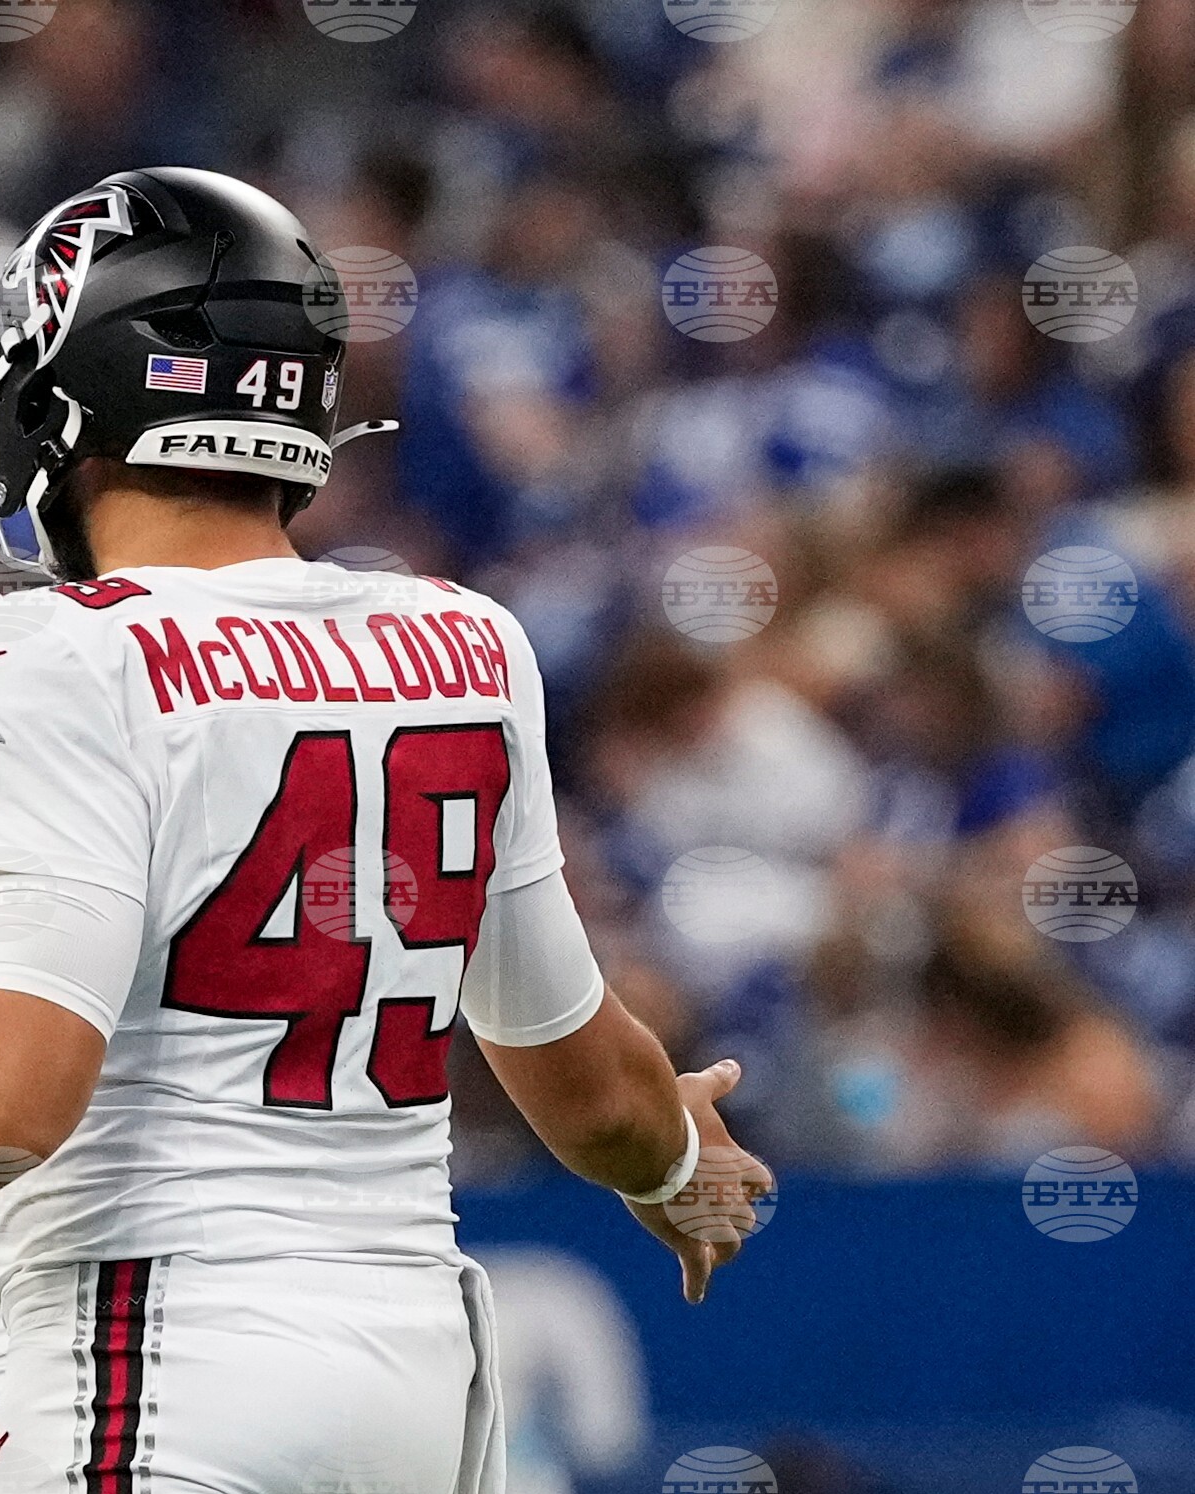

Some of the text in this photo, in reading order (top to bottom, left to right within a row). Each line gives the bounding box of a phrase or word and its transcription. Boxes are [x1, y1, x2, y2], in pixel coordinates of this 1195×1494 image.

[235, 358, 305, 411] 49
[159, 434, 332, 475] FALCONS
[126, 610, 512, 715] McCULLOUGH
[159, 721, 511, 1111] 49
